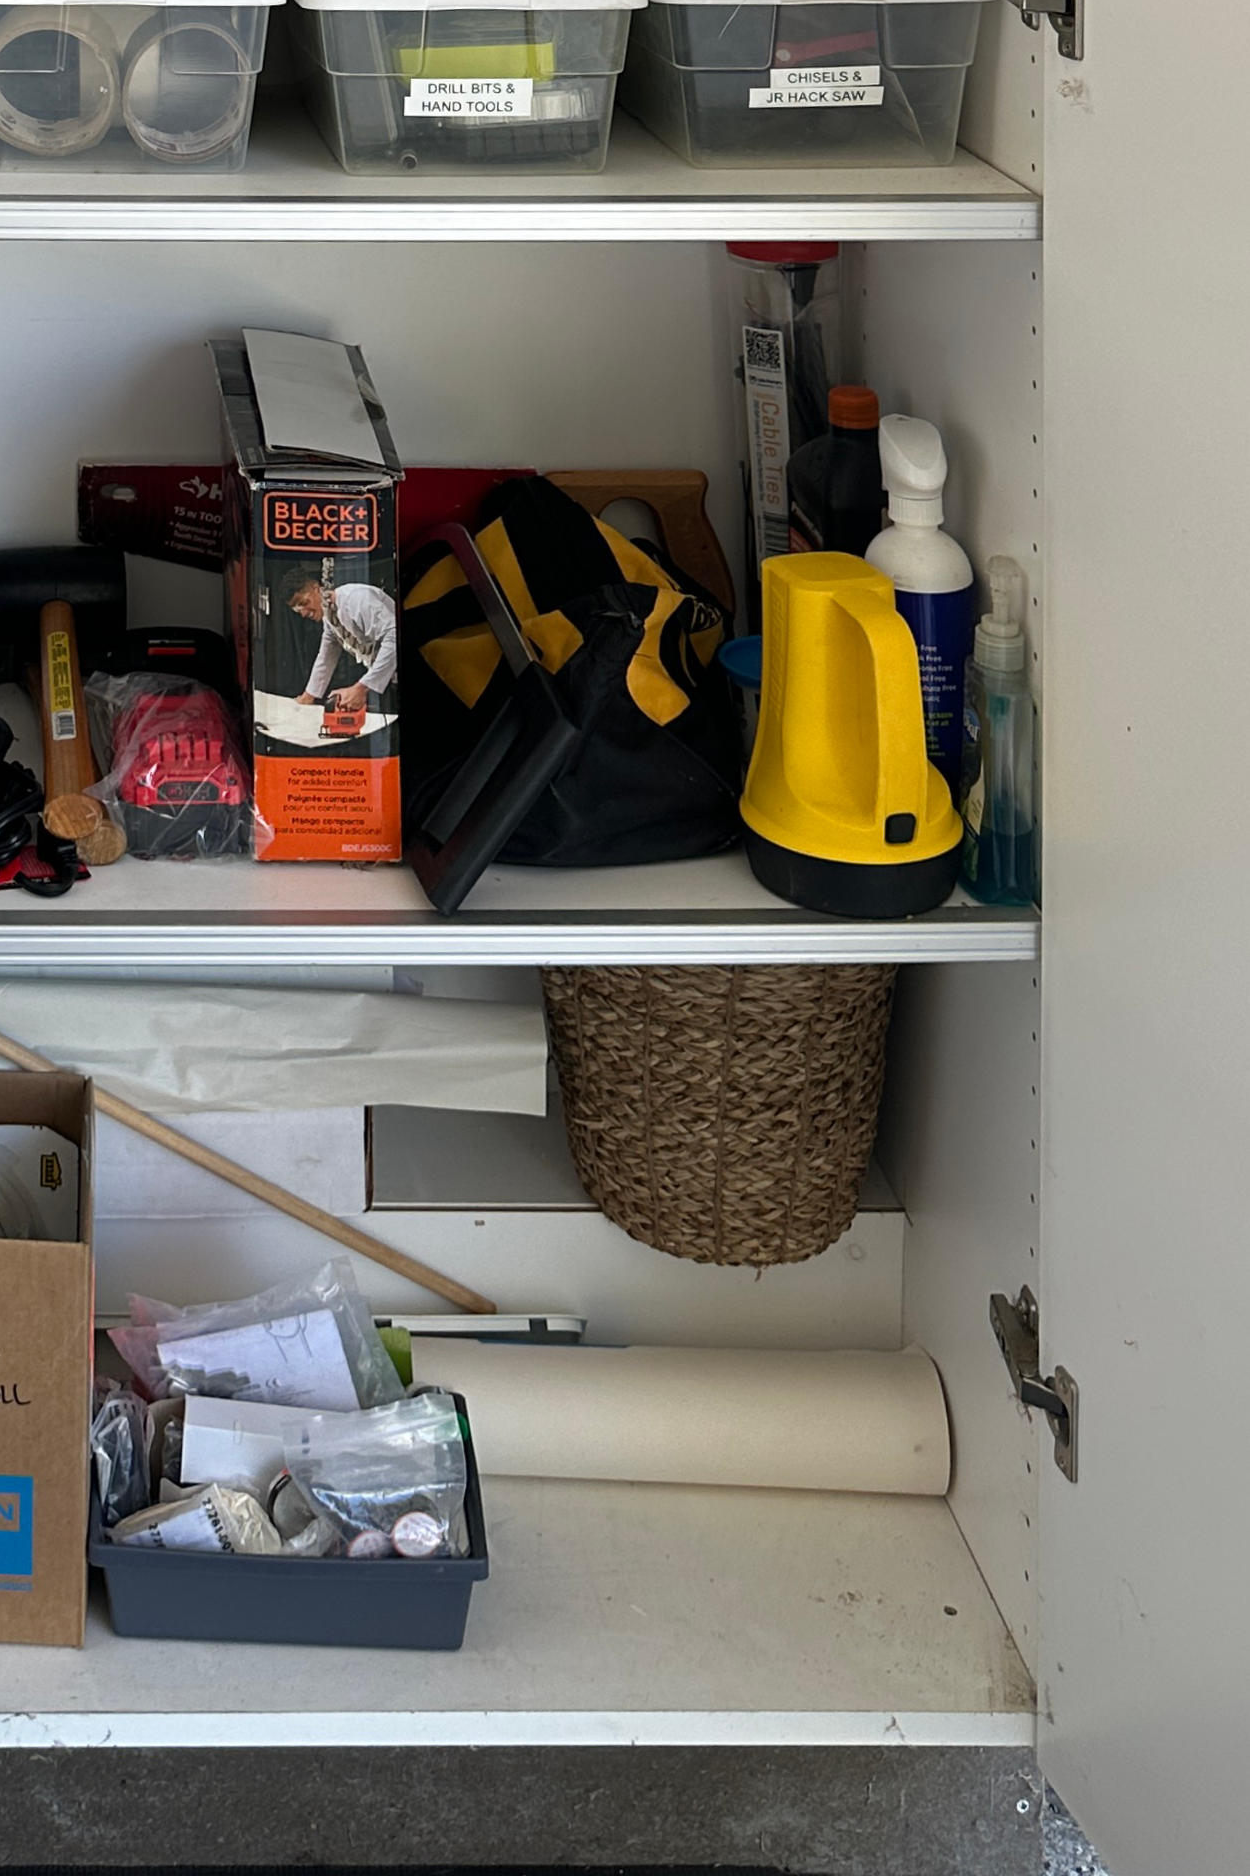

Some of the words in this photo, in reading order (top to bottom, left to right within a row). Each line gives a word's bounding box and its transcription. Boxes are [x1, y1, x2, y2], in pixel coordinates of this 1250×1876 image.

[787, 71, 848, 84] CHISELS
[852, 71, 863, 83] &
[427, 83, 468, 96] DRILL
[471, 83, 503, 95] BITS
[506, 83, 516, 95] &
[766, 90, 785, 103] JR
[786, 90, 828, 103] HACK
[831, 89, 866, 102] SAW
[421, 100, 463, 114] HAND
[466, 100, 514, 113] TOOLS
[761, 401, 781, 458] Cable
[766, 465, 784, 505] Ties
[274, 501, 368, 522] BLACK+
[274, 521, 370, 542] DECKER
[290, 767, 332, 777] Compact
[333, 769, 365, 777] Handle
